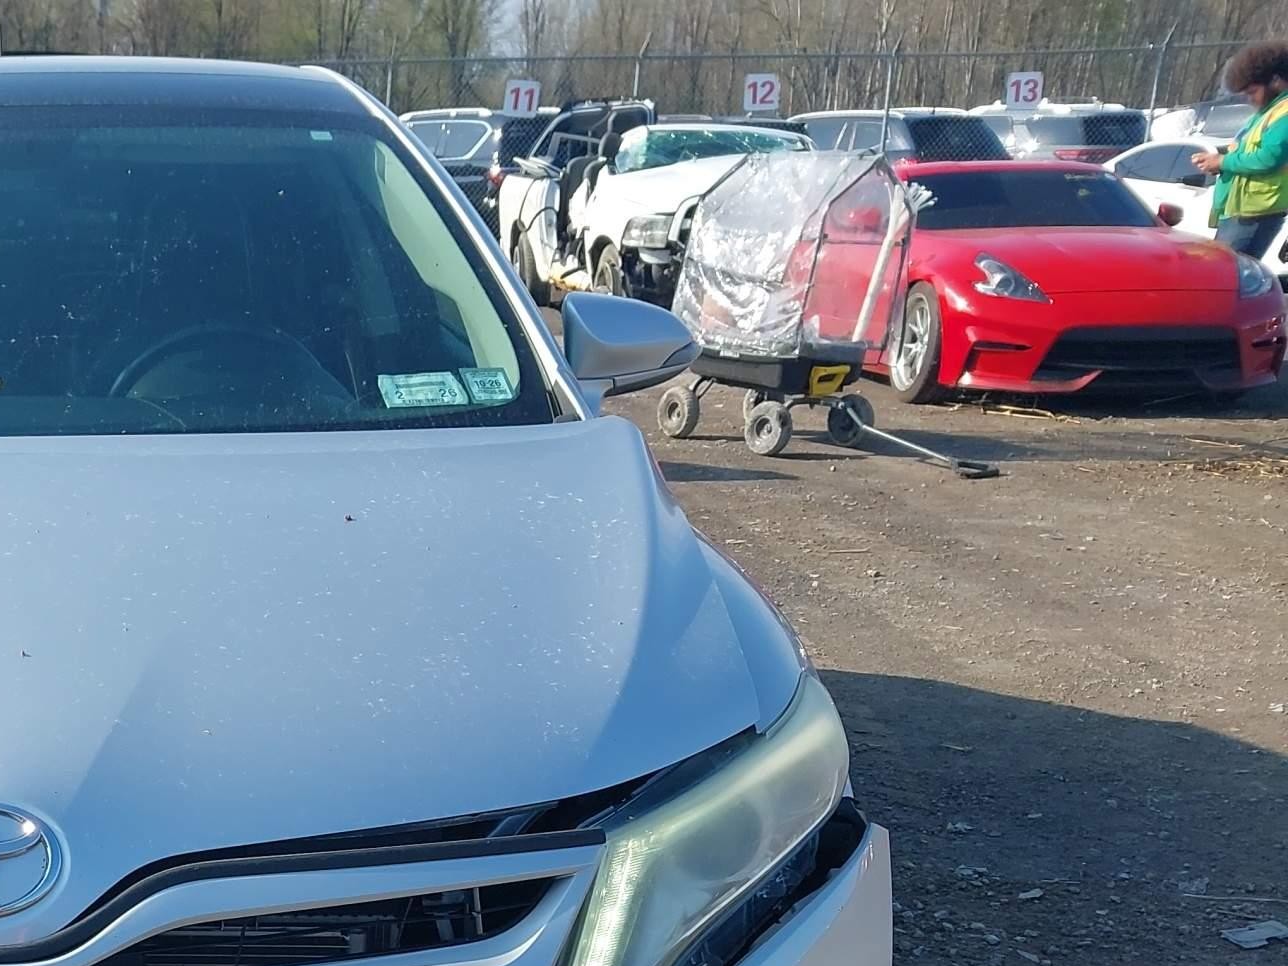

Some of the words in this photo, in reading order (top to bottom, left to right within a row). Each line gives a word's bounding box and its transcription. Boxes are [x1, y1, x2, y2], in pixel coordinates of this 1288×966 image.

[510, 86, 535, 112] 11
[747, 80, 775, 105] 12
[1010, 78, 1039, 103] 13
